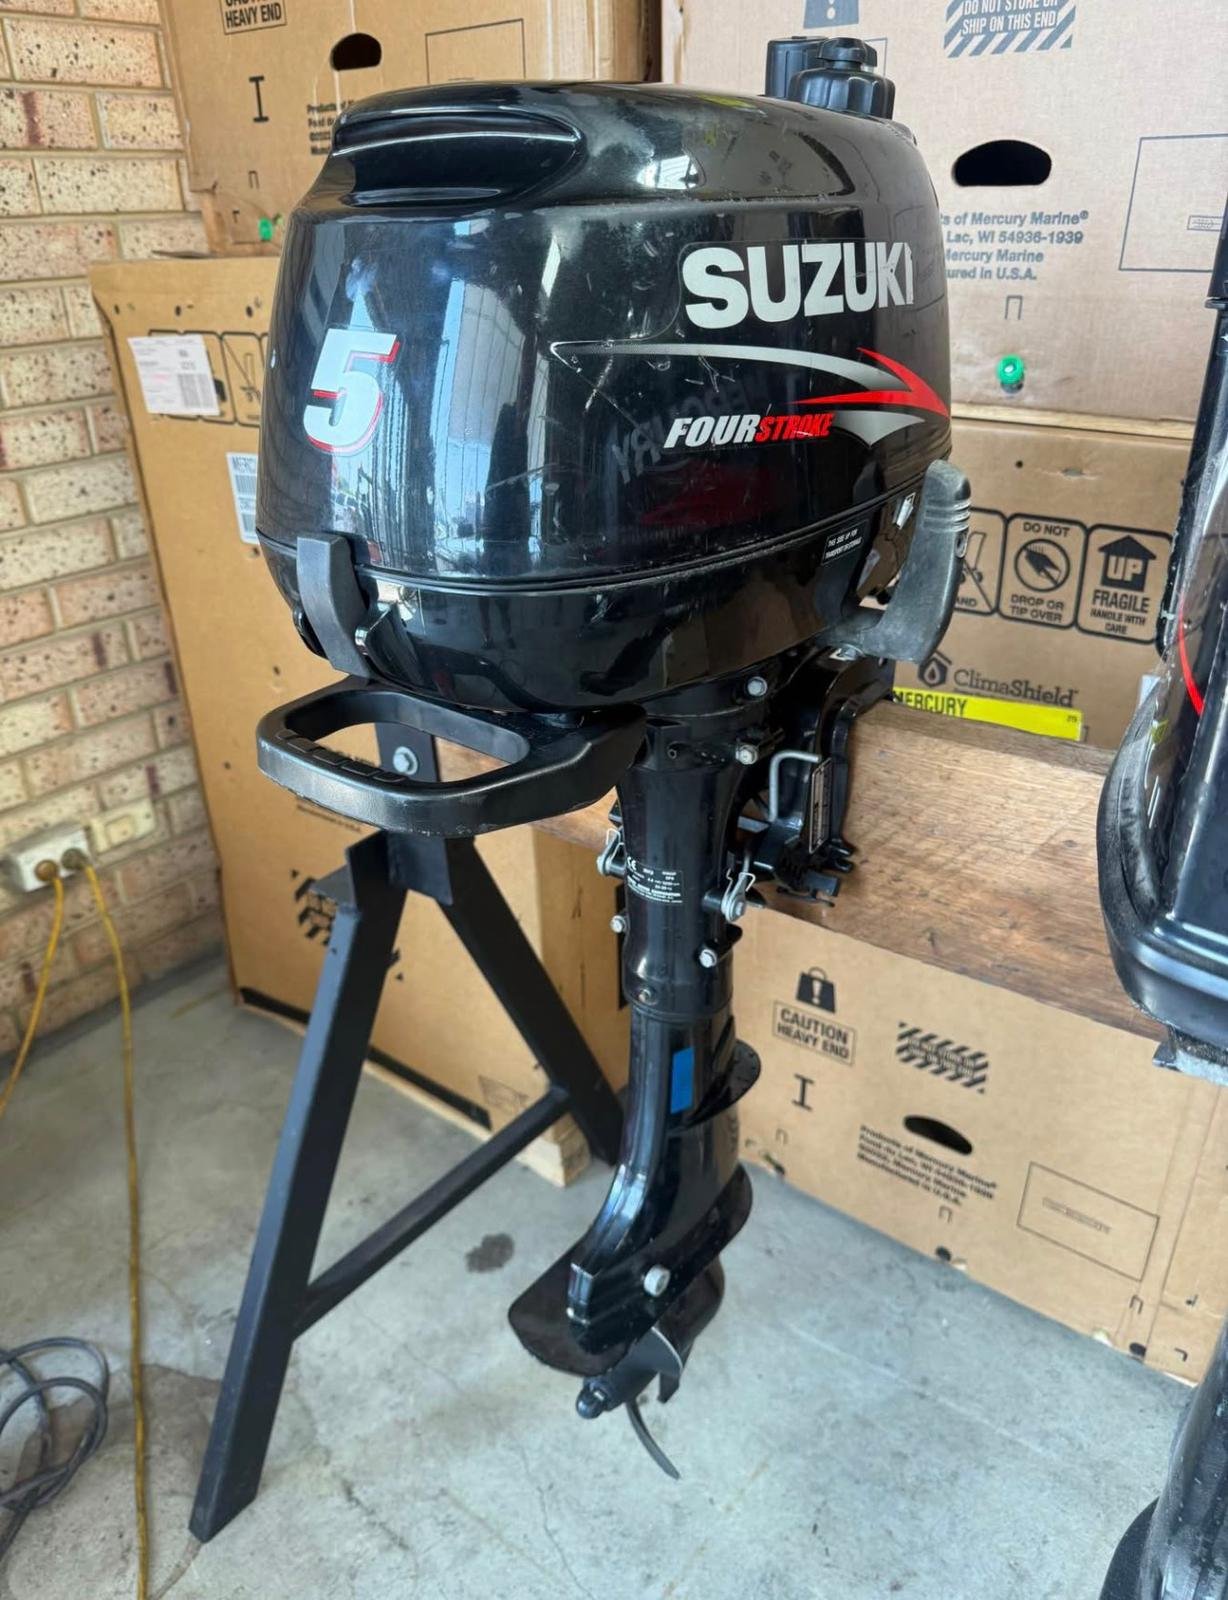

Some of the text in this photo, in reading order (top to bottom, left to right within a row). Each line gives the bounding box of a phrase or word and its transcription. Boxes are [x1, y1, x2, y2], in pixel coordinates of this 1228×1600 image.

[225, 2, 282, 29] HEAVY END
[962, 18, 987, 34] SHIP
[989, 16, 1005, 32] ON
[1008, 13, 1032, 30] THIS
[954, 212, 967, 226] of
[971, 212, 1027, 227] Mercury
[946, 231, 974, 245] Lac,
[978, 231, 996, 243] WI
[996, 250, 1044, 263] Marine
[980, 268, 992, 279] in
[996, 267, 1037, 280] U.S.A.
[682, 241, 914, 329] SUZUKI
[303, 328, 400, 456] 5
[1022, 521, 1071, 537] DO NOT
[1106, 555, 1144, 582] UP
[1010, 594, 1065, 611] DROP OR
[1092, 589, 1151, 614] FRAGILE
[1010, 605, 1063, 623] TIP OVER
[1090, 608, 1147, 626] HANDLE WITH
[1105, 622, 1128, 635] CARE
[780, 1008, 848, 1045] CAUTION
[777, 1022, 850, 1060] HEAVY END
